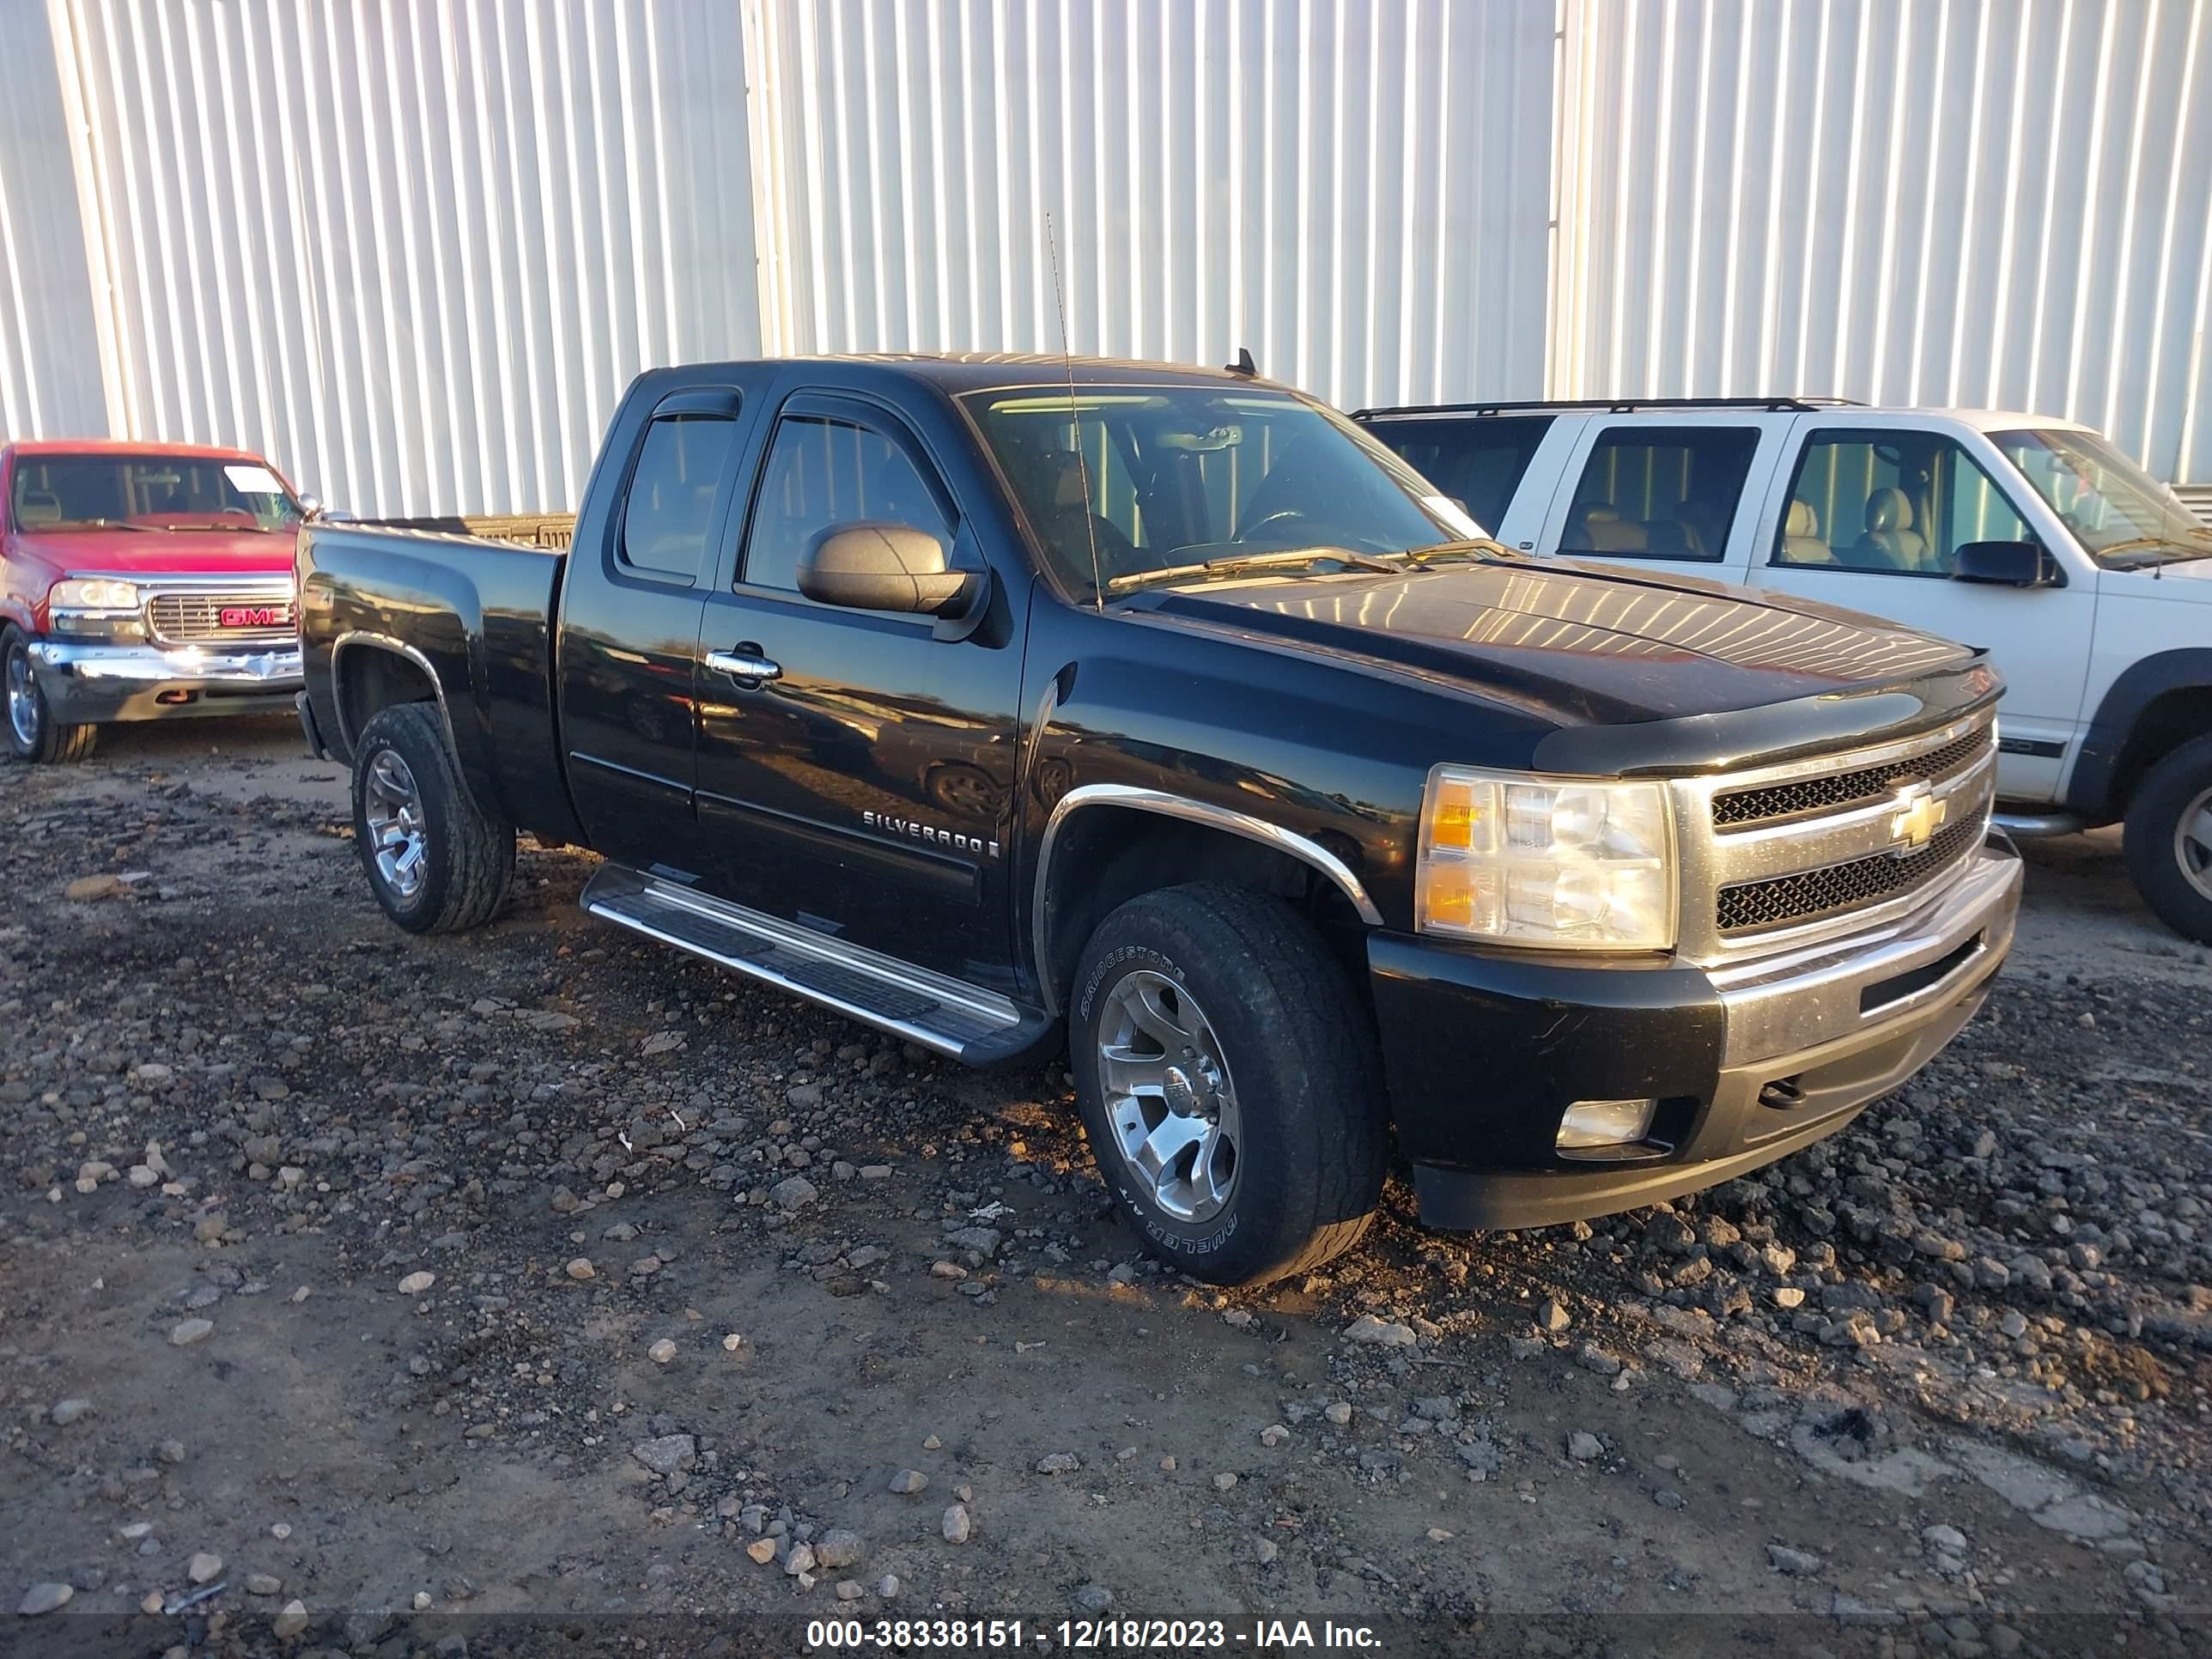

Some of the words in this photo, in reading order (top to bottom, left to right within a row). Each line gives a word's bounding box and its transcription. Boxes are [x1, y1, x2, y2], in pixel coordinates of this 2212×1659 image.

[221, 607, 289, 626] GMC
[863, 811, 982, 853] SILVERADO
[1080, 945, 1185, 1023] BRIDGESTONE
[1146, 1212, 1238, 1255] DUELER
